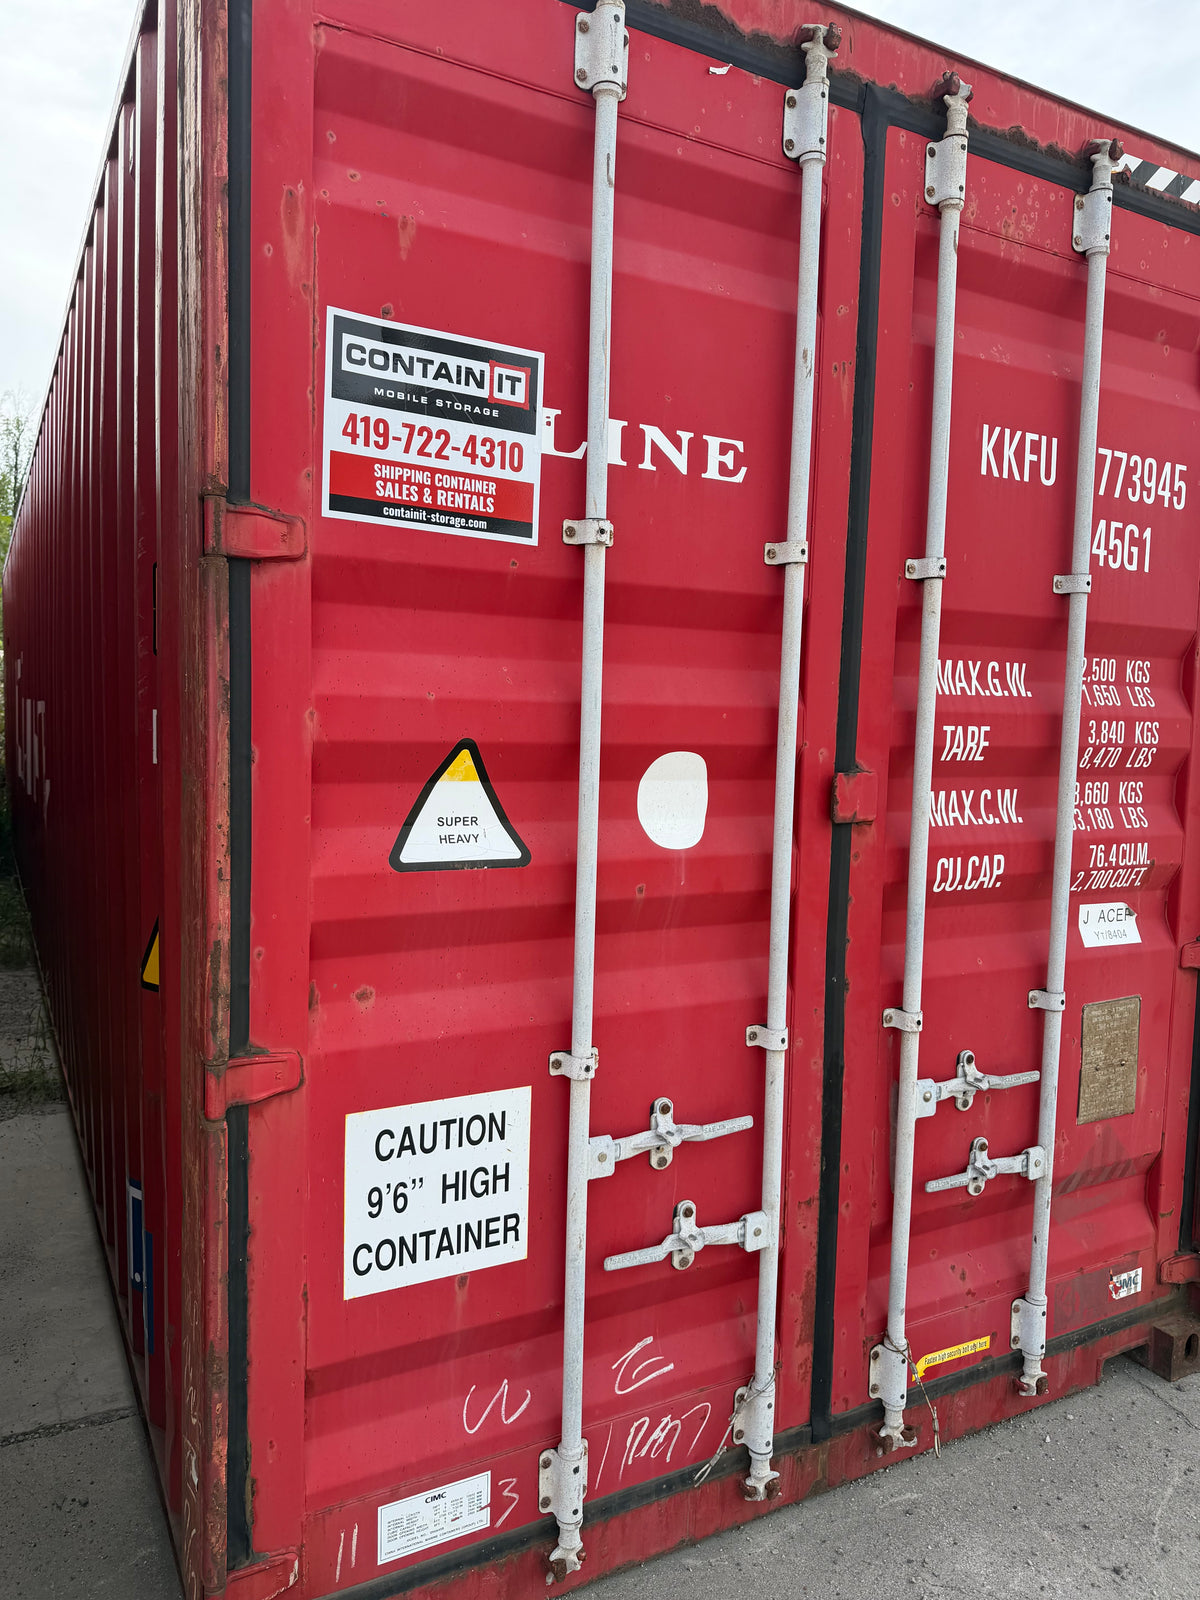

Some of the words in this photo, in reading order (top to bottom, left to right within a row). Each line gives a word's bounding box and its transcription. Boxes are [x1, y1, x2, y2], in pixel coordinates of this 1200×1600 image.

[374, 387, 428, 404] MOBILE
[436, 399, 500, 418] STORAGE
[341, 412, 524, 473] 419-722-4310
[541, 407, 748, 484] LINE
[374, 463, 432, 486] SHIPPING
[434, 472, 497, 496] CONTAINER
[980, 423, 1058, 487] KKFU
[1097, 447, 1188, 511] 773945
[375, 479, 419, 502] SALES
[423, 487, 433, 504] &
[437, 491, 495, 514] RENTALS
[383, 505, 488, 530] containit-storage.com
[1091, 519, 1152, 573] 45G1
[936, 659, 1033, 698] MAX.G.W.
[1125, 659, 1151, 684] KGS
[1126, 685, 1156, 708] LBS
[940, 725, 991, 762] TARE
[1087, 720, 1125, 745] 3,840
[1134, 721, 1160, 745] KGS
[1079, 747, 1121, 770] 8,470
[1125, 747, 1157, 768] LBS
[437, 816, 479, 827] SUPER
[929, 788, 1024, 828] MAX.C.W.
[1118, 781, 1144, 804] KGS
[1119, 806, 1149, 829] LBS
[438, 833, 480, 845] HEAVY
[932, 854, 1005, 893] CU.CAP.
[374, 1110, 506, 1162] CAUTION
[441, 1162, 510, 1205] HIGH
[352, 1212, 521, 1277] CONTAINER
[924, 1354, 938, 1366] Fasten
[938, 1352, 947, 1363] high
[947, 1348, 962, 1360] security
[424, 1491, 447, 1504] CIMC
